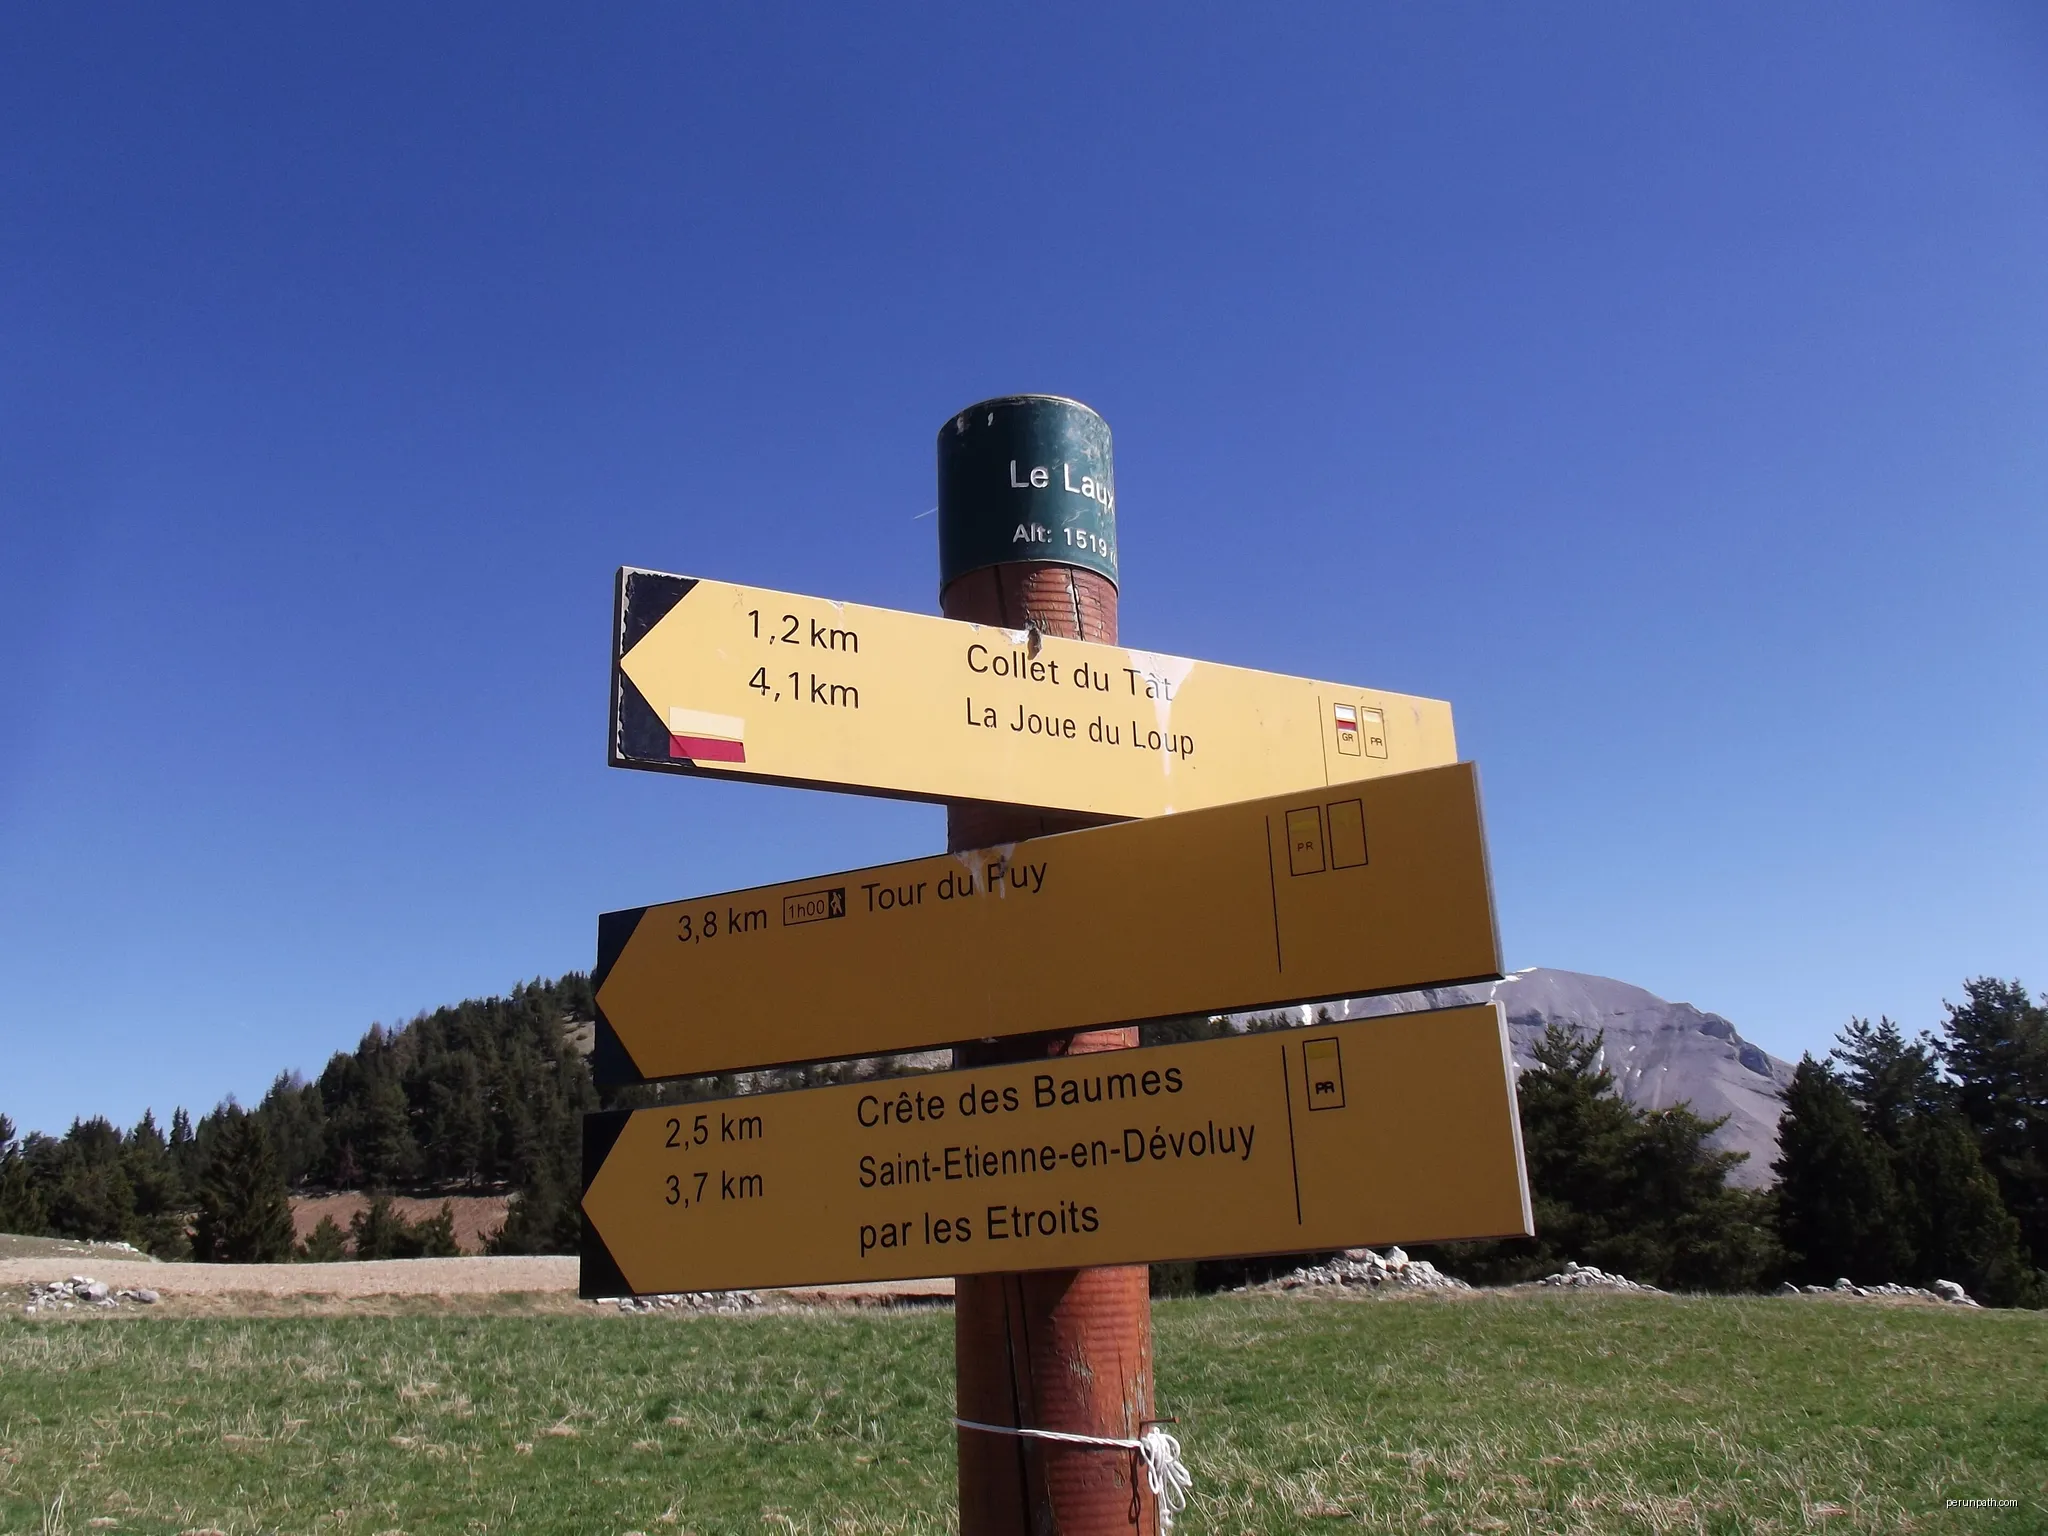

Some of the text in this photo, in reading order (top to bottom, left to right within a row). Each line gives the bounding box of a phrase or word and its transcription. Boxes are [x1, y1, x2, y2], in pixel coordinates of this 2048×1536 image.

[1010, 460, 1049, 488] Le
[1012, 523, 1107, 558] Alt: 1519
[748, 610, 859, 653] 1,2 km
[966, 644, 1060, 685] Collet
[1073, 662, 1110, 692] du
[748, 667, 859, 708] 4,1 km
[966, 697, 1195, 759] La Joue du Loup
[1341, 732, 1354, 742] GR
[1370, 737, 1383, 746] PR
[1297, 842, 1314, 851] PR
[861, 862, 1047, 912] Tour du Puy
[677, 908, 767, 944] 3,8 km
[788, 900, 825, 919] 1h00
[857, 1067, 1183, 1128] Crête des Baumes
[1315, 1081, 1335, 1094] PR
[665, 1112, 763, 1151] 2,5 km
[858, 1121, 1255, 1188] Saint-Etienne-en-Dévoluy
[665, 1170, 763, 1208] 3,7 km
[858, 1201, 1099, 1257] par les Etroits
